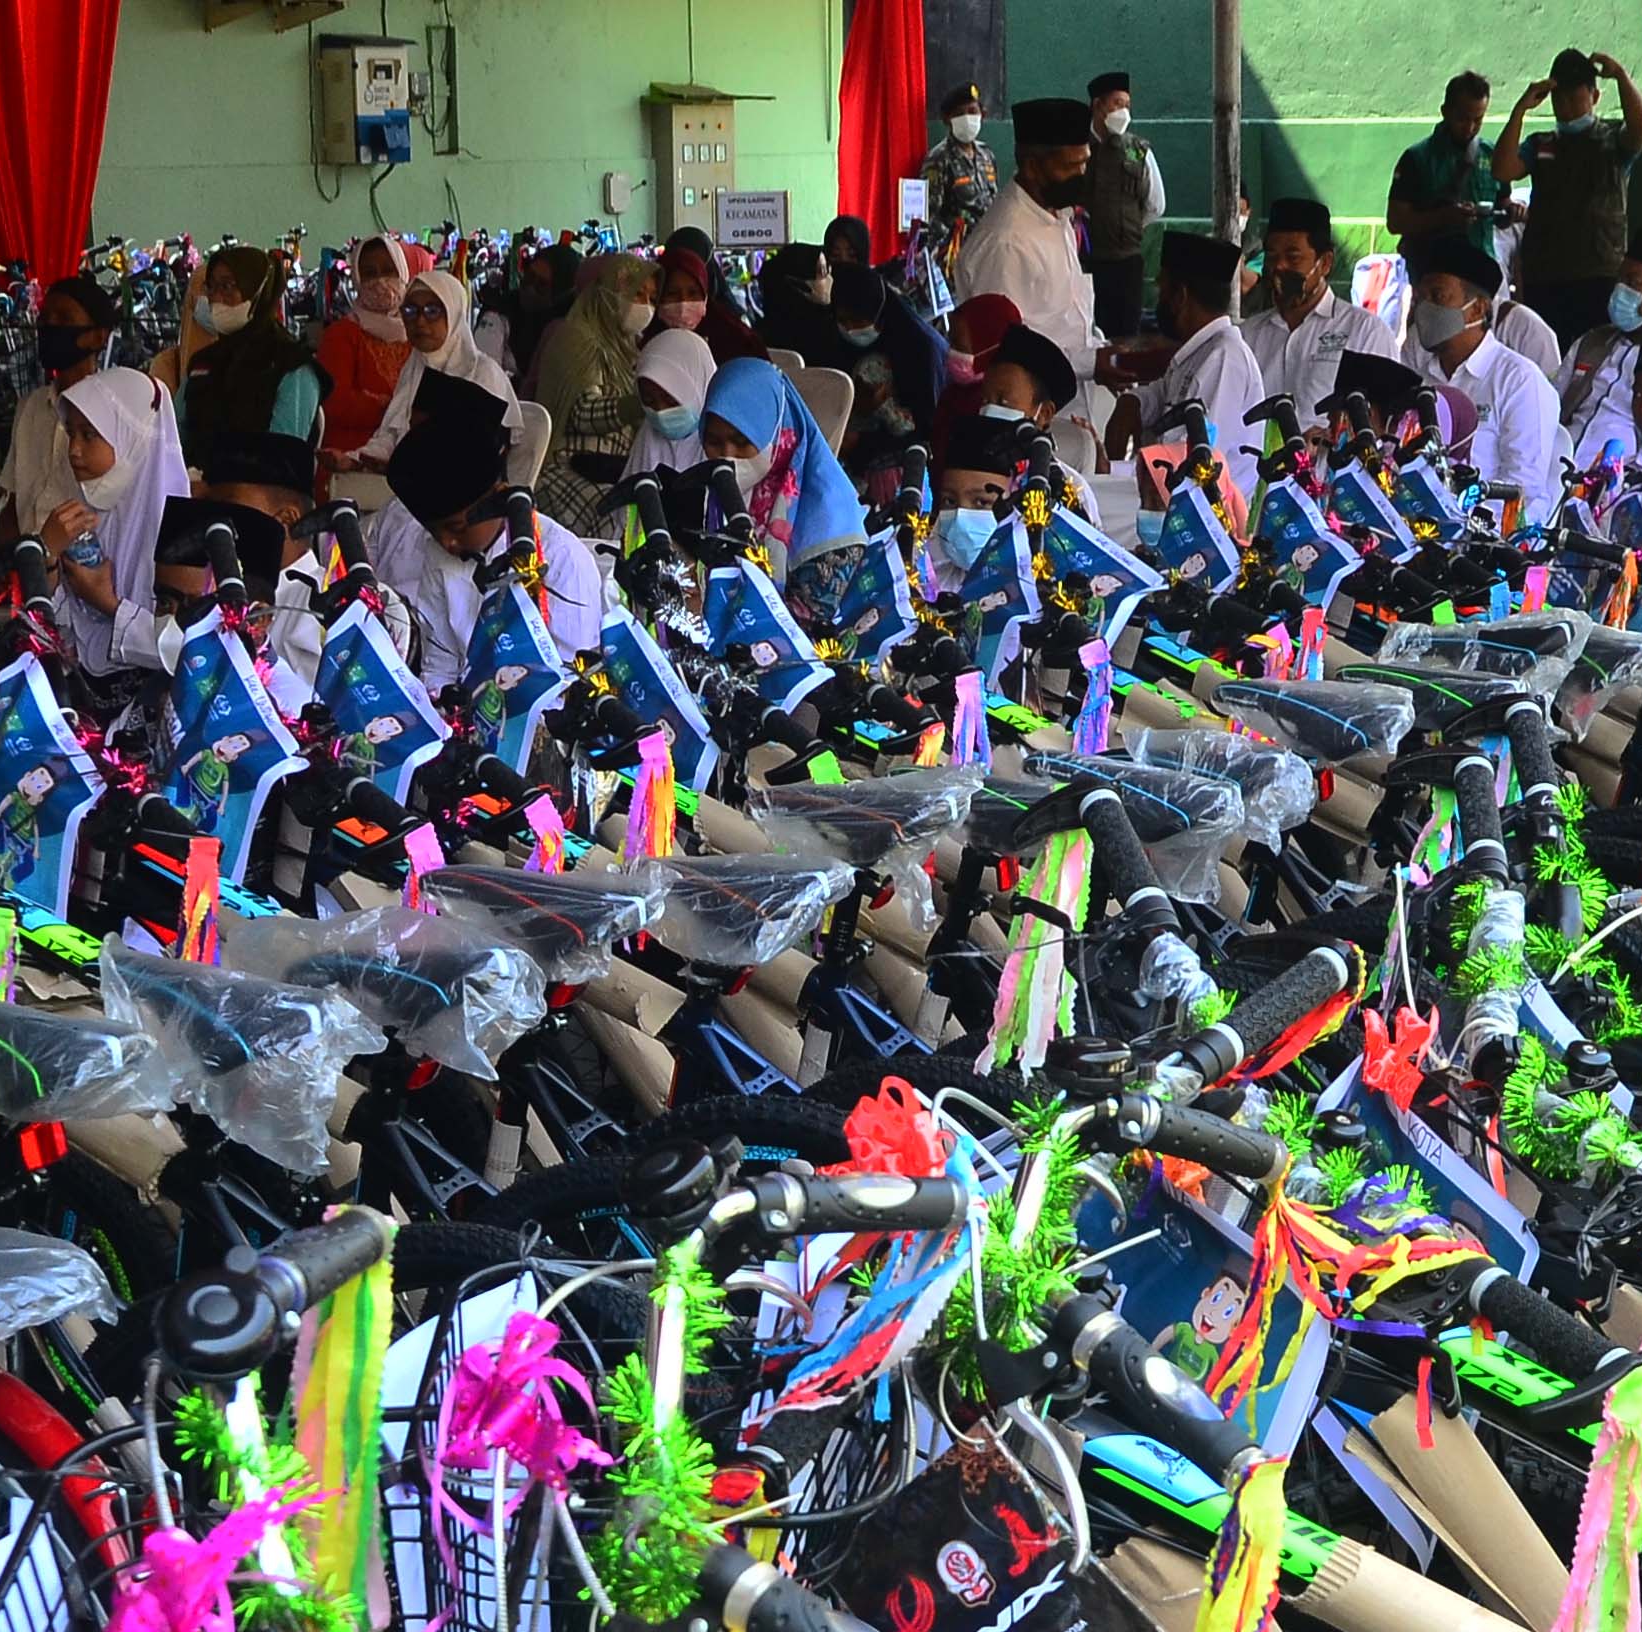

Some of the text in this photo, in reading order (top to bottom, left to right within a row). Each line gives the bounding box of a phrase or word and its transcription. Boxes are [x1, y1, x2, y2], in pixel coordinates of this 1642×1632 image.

[725, 208, 778, 220] KECAMATAN
[731, 229, 773, 239] GEBOG
[1407, 1115, 1443, 1164] KOTA
[1457, 1357, 1524, 1402] 172
